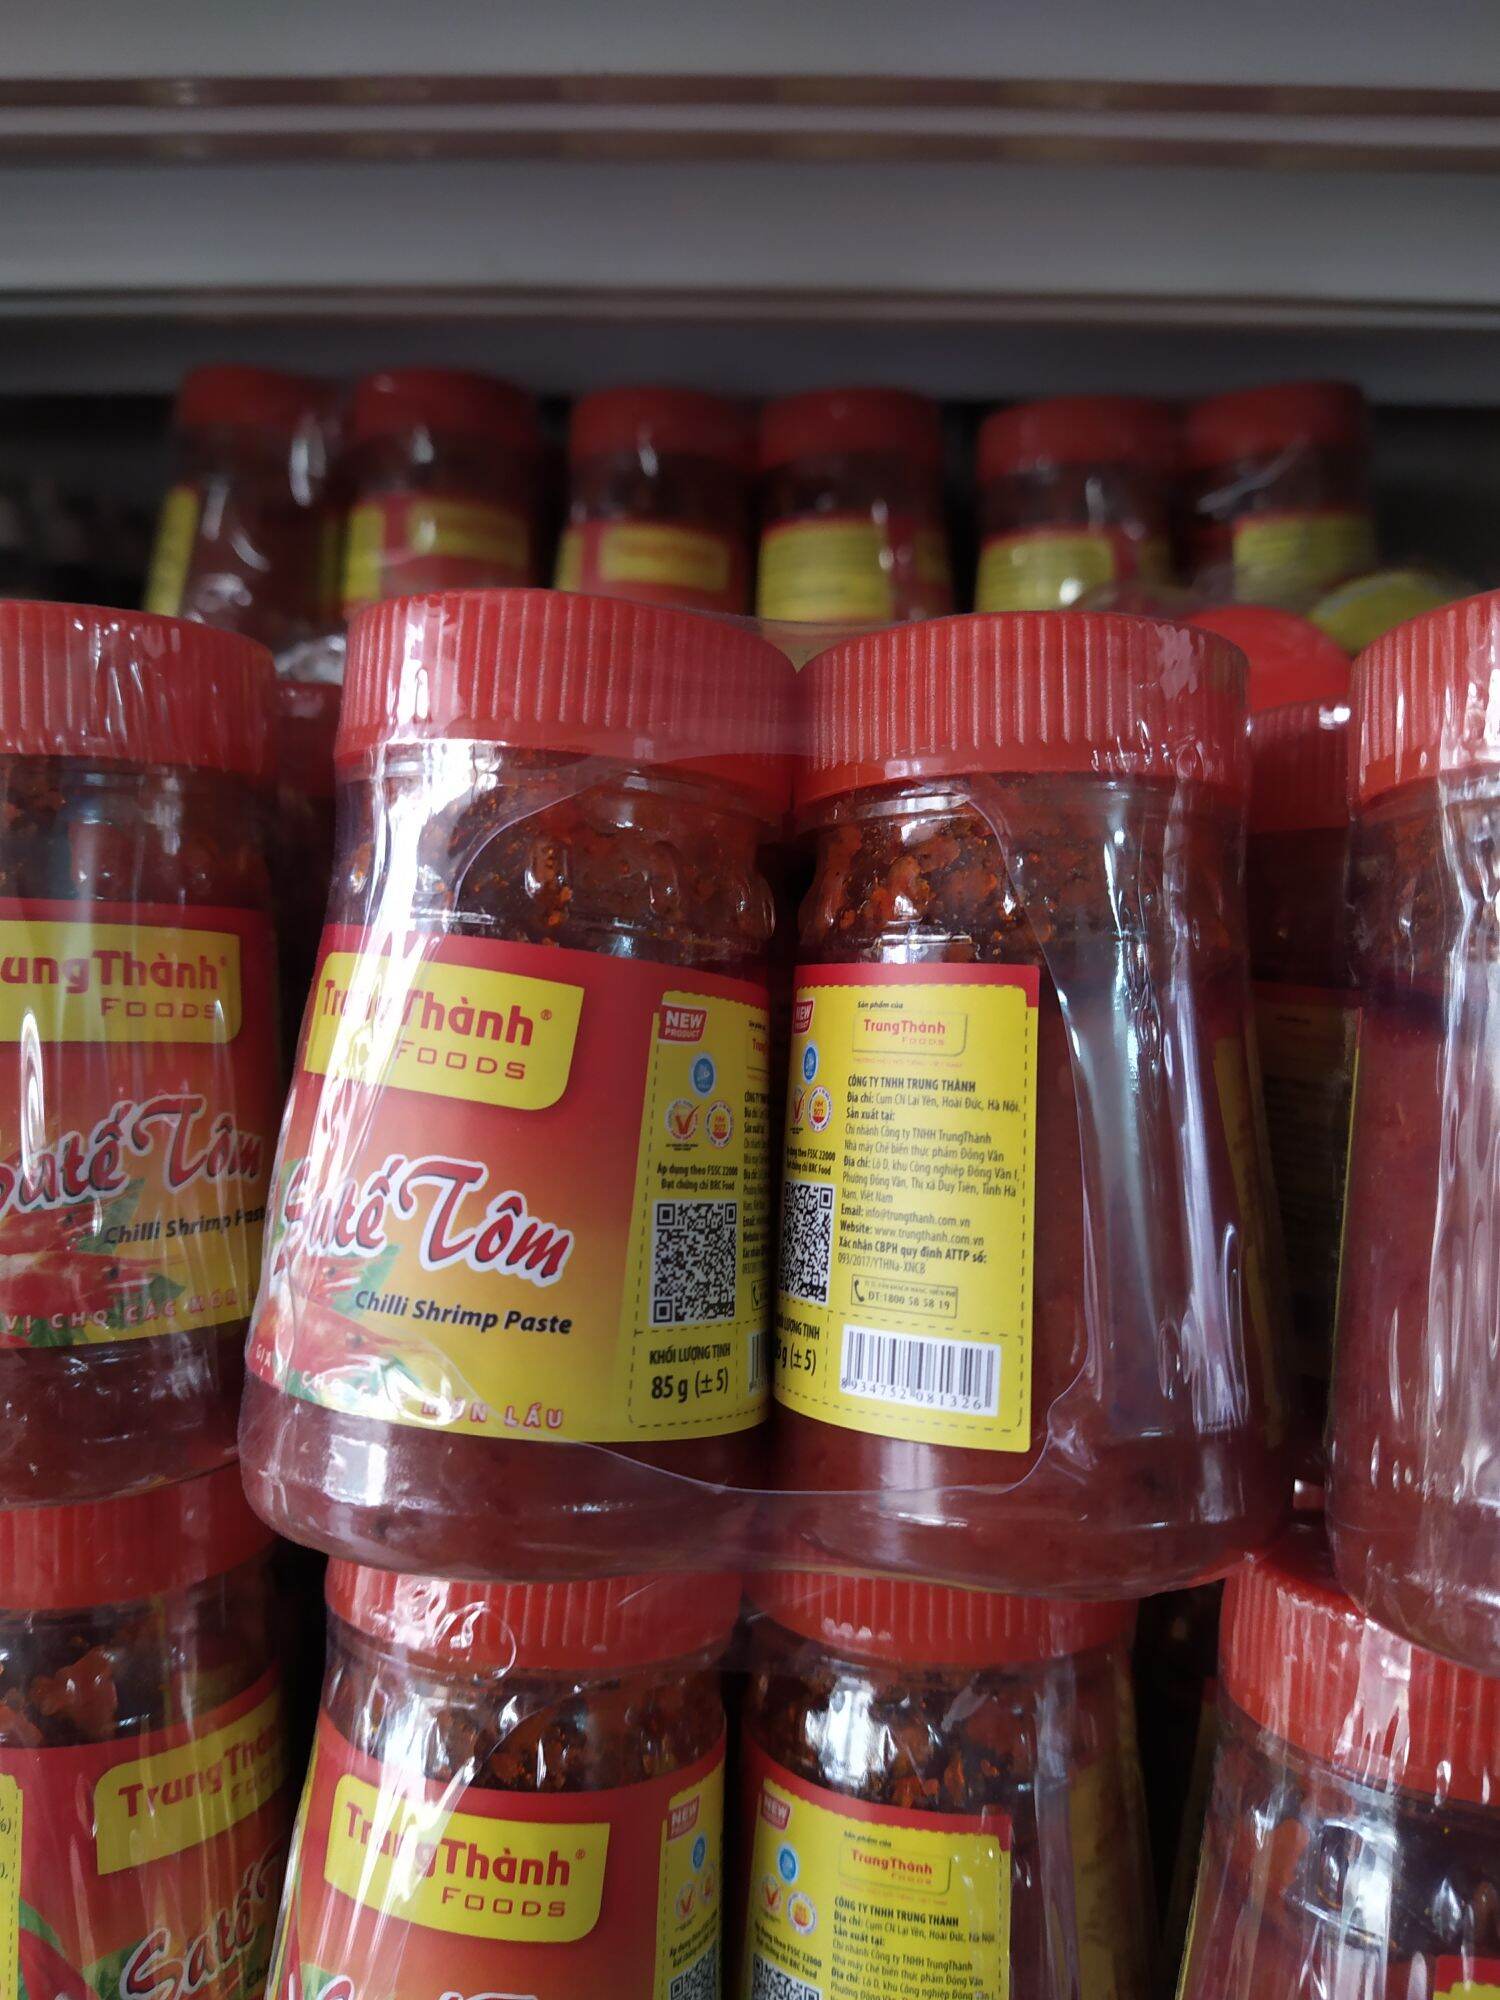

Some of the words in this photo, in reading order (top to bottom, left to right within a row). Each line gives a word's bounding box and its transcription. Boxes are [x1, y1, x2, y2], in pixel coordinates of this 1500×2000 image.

[0, 950, 220, 994] ungThành
[101, 997, 216, 1019] FOODS
[321, 979, 534, 1047] TrThành
[665, 1010, 703, 1028] NEW
[396, 1040, 526, 1080] FOODS
[847, 1073, 868, 1088] CÔNG
[869, 1076, 879, 1088] TY
[881, 1077, 904, 1089] TNHH
[906, 1078, 938, 1091] TRUNG
[942, 1078, 976, 1093] THÀNH
[846, 1106, 859, 1118] Sản
[861, 1108, 879, 1120] xuất
[987, 1099, 1000, 1111] Hà
[880, 1125, 900, 1140] Công
[902, 1128, 910, 1138] ty
[912, 1127, 936, 1139] TNHH
[875, 1191, 894, 1203] Nam
[938, 1179, 955, 1194] Duy
[398, 1157, 572, 1279] Tôm
[841, 1203, 863, 1217] Email:
[104, 1218, 161, 1244] Chilli
[166, 1212, 232, 1240] Shrimp
[235, 1205, 267, 1228] Past
[840, 1219, 872, 1234] Website:
[839, 1235, 851, 1249] Xác
[875, 1240, 898, 1254] CBPH
[900, 1246, 917, 1259] quy
[945, 1248, 970, 1261] ATTP
[973, 1249, 988, 1264] số:
[356, 1290, 409, 1315] Chilli
[413, 1300, 498, 1330] Shrimp
[504, 1310, 572, 1335] Paste
[939, 1300, 951, 1310] 19
[652, 1375, 673, 1400] 85
[678, 1379, 688, 1403] g
[118, 1725, 276, 1817] TrungTh
[441, 1887, 566, 1918] FOODS
[835, 1895, 856, 1910] CÔNG
[858, 1902, 868, 1914] TY
[870, 1904, 894, 1919] TNHH
[896, 1909, 926, 1924] TRUNG
[928, 1912, 959, 1928] THÀNH
